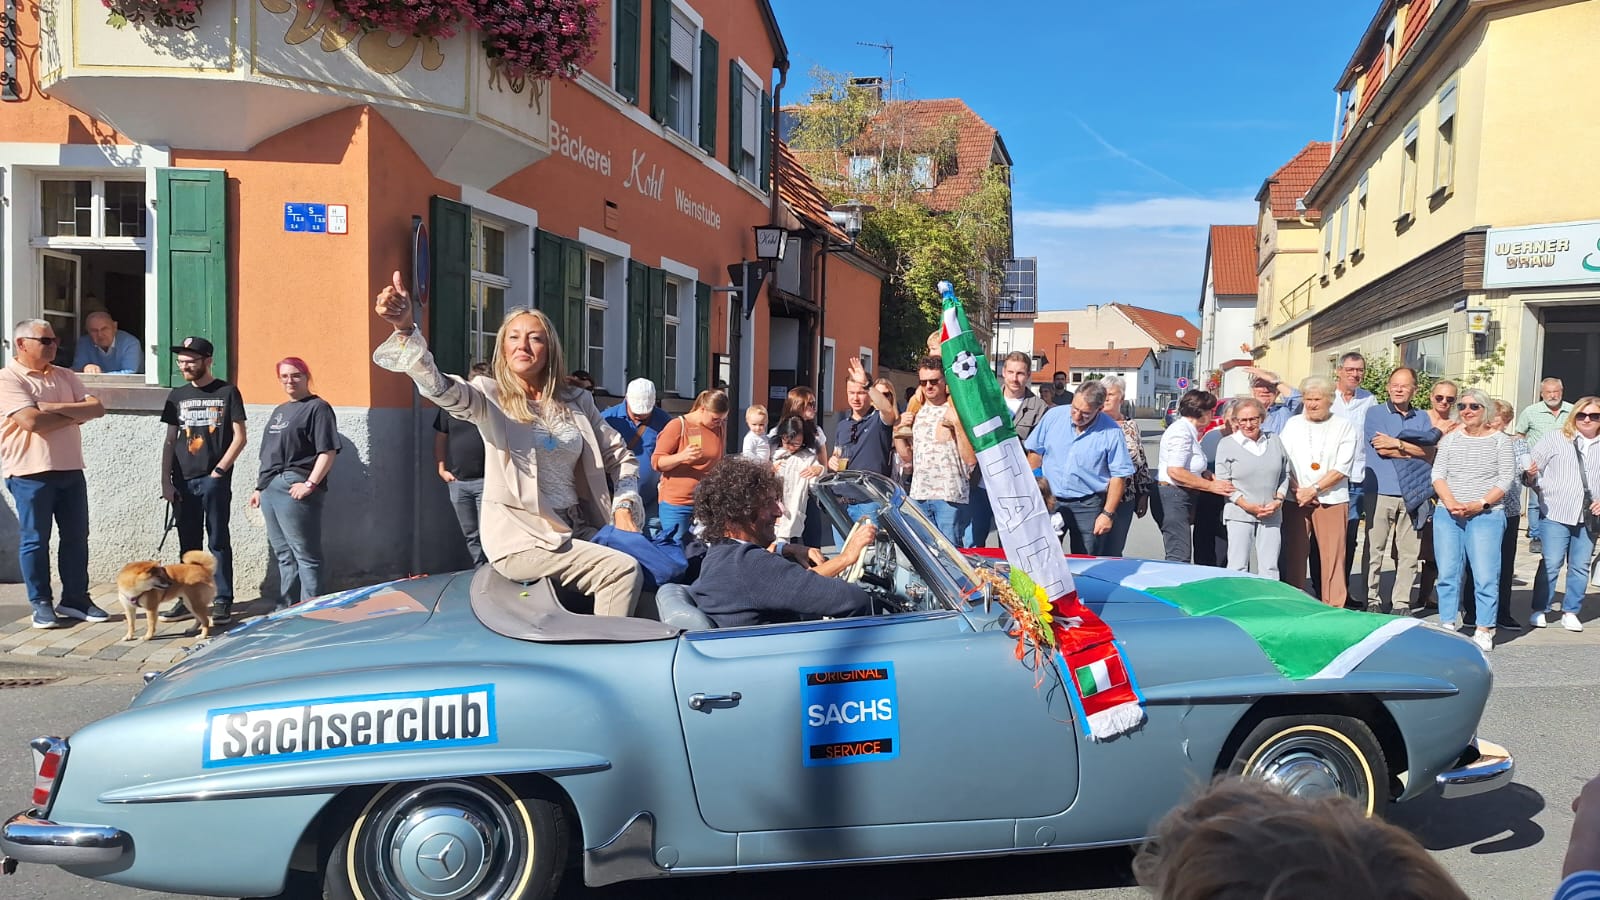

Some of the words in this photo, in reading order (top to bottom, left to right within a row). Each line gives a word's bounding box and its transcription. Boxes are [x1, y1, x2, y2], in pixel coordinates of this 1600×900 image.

[550, 120, 611, 176] Bäckerei
[623, 149, 665, 201] Kohl
[675, 186, 721, 230] Weinstube
[1494, 239, 1570, 256] WERNER
[815, 669, 883, 683] ORIGINAL
[808, 698, 893, 727] SACHS
[222, 694, 482, 759] Sachserclub
[826, 741, 882, 759] SERVICE
